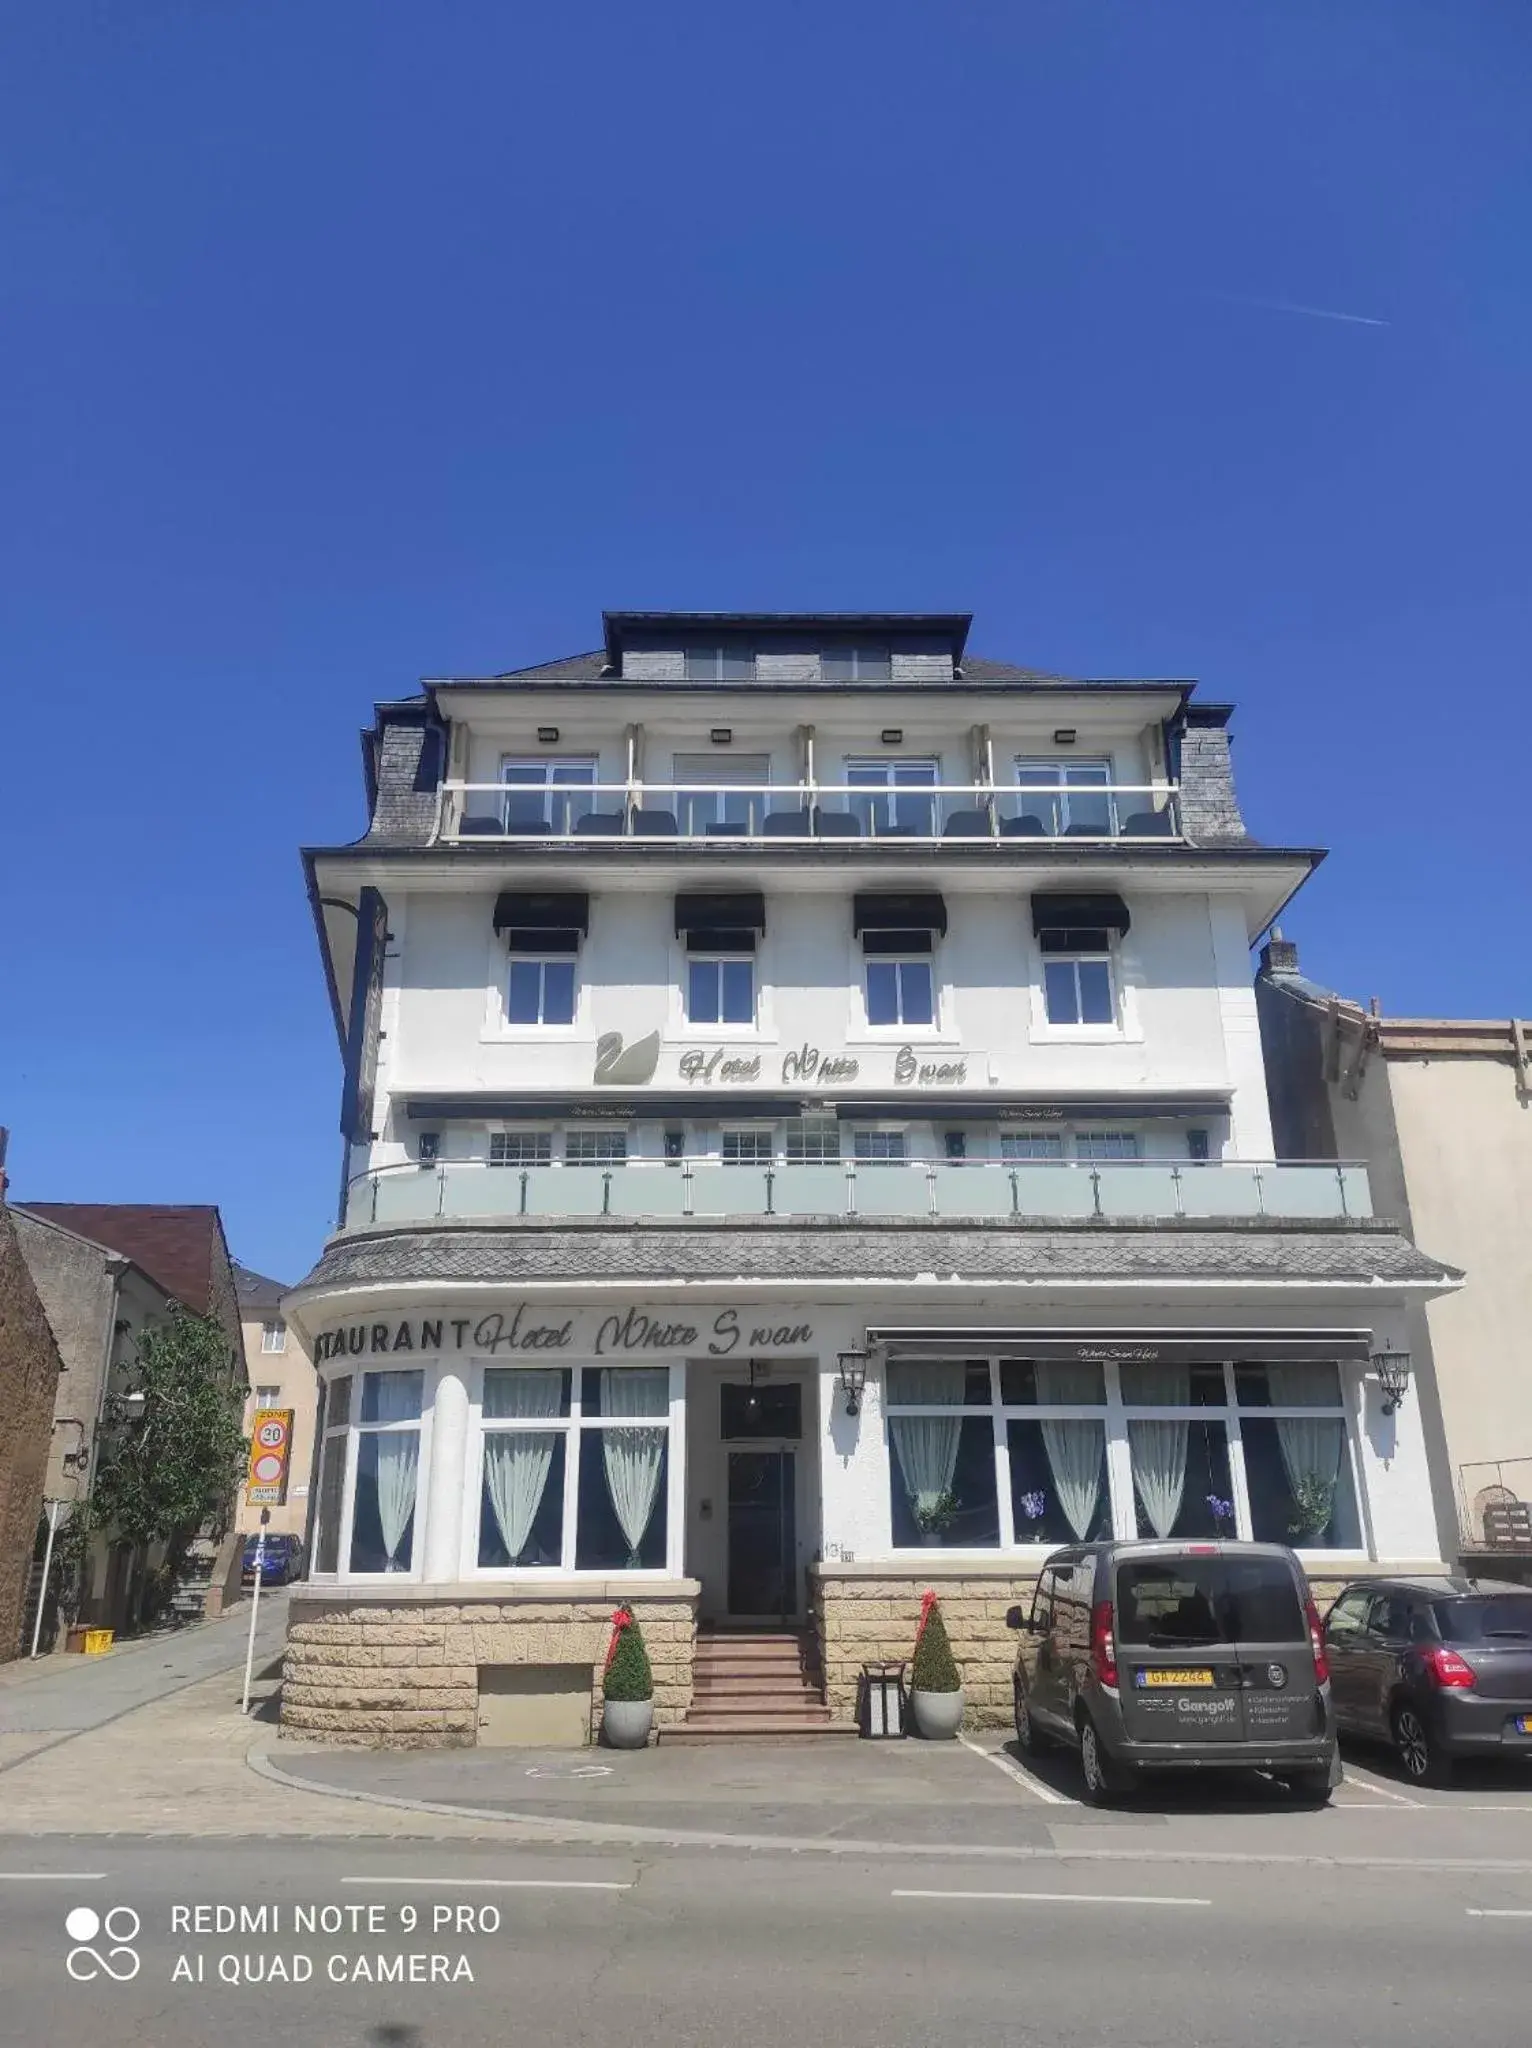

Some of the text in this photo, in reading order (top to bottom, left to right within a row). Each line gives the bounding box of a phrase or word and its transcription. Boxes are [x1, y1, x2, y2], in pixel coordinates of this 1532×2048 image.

[680, 1043, 967, 1084] Hotel White Swan
[474, 1303, 812, 1355] Hotel White Swan
[263, 1428, 280, 1441] 30
[1178, 1698, 1235, 1715] Gangolf
